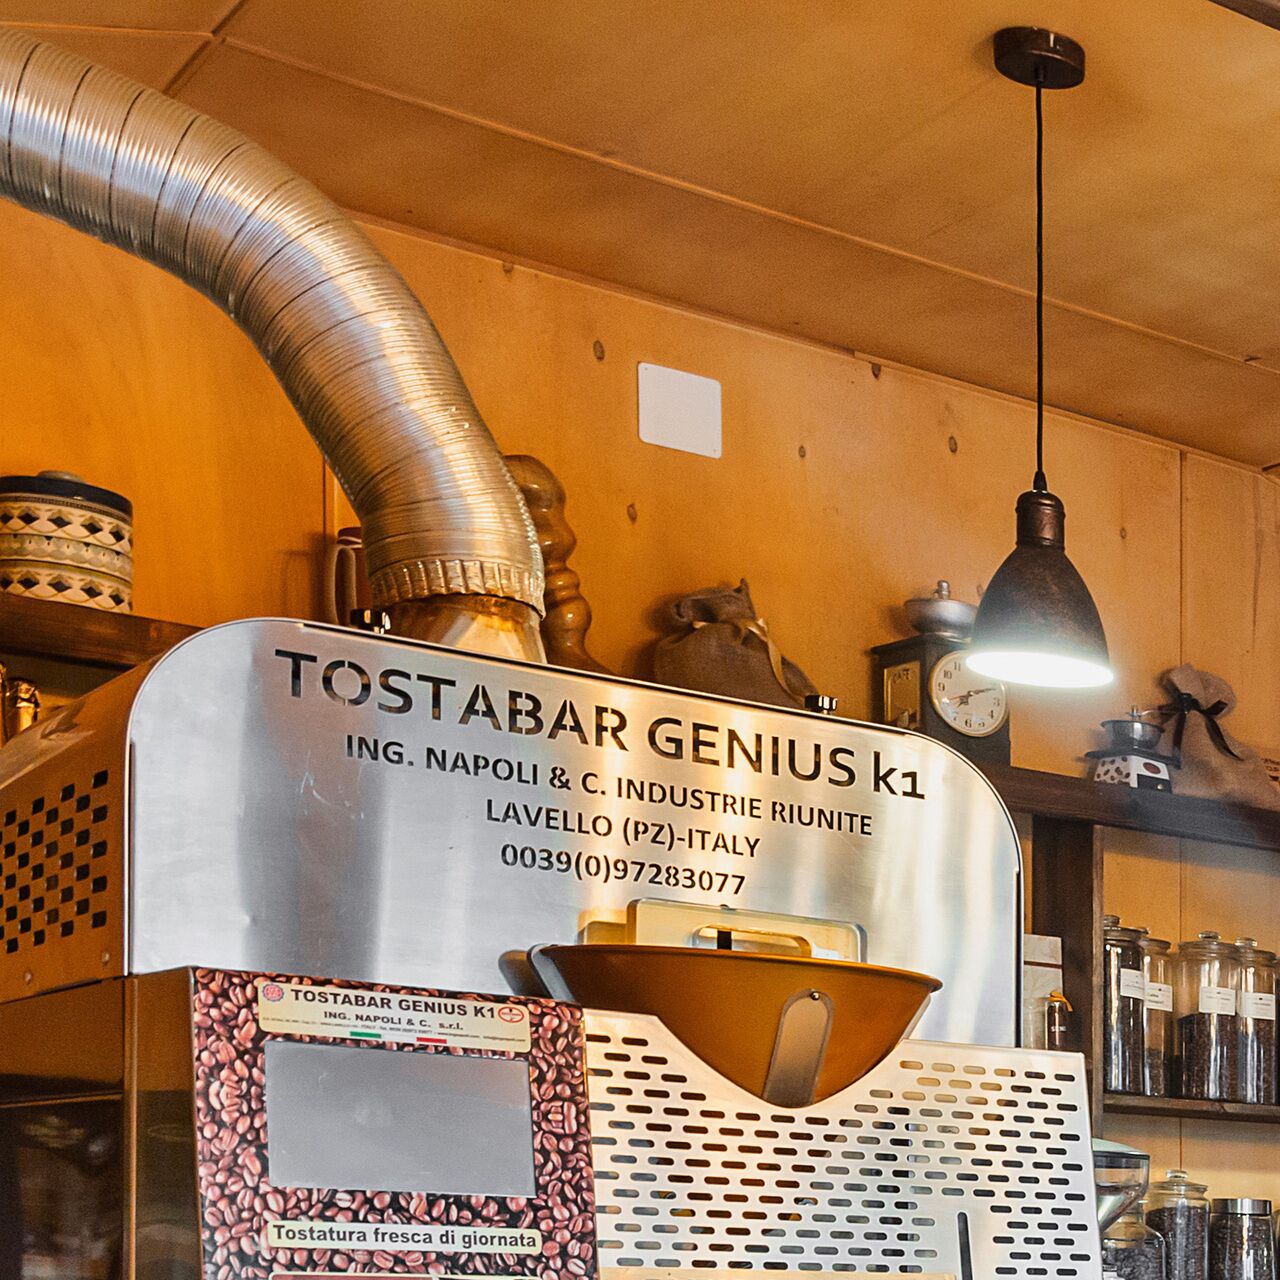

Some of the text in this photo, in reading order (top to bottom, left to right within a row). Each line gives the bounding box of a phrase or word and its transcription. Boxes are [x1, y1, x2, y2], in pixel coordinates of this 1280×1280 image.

[275, 648, 630, 752] TOSTABAR
[647, 717, 856, 789] GENIUS
[346, 735, 873, 836] ING. NAPOLI & C. INDUSTRIE RIUNITE
[486, 800, 760, 859] LAVELLO (PZ)-ITALY
[501, 844, 746, 897] 0039(0)97283077
[291, 989, 392, 1010] TOSTABAR
[399, 999, 467, 1016] GENIUS
[474, 1005, 495, 1019] K1
[324, 1011, 350, 1021] ING.
[355, 1013, 402, 1026] NAPOLI
[407, 1017, 415, 1026] &
[419, 1019, 431, 1028] C.
[273, 1224, 537, 1249] Tostatura fresca di giornata
